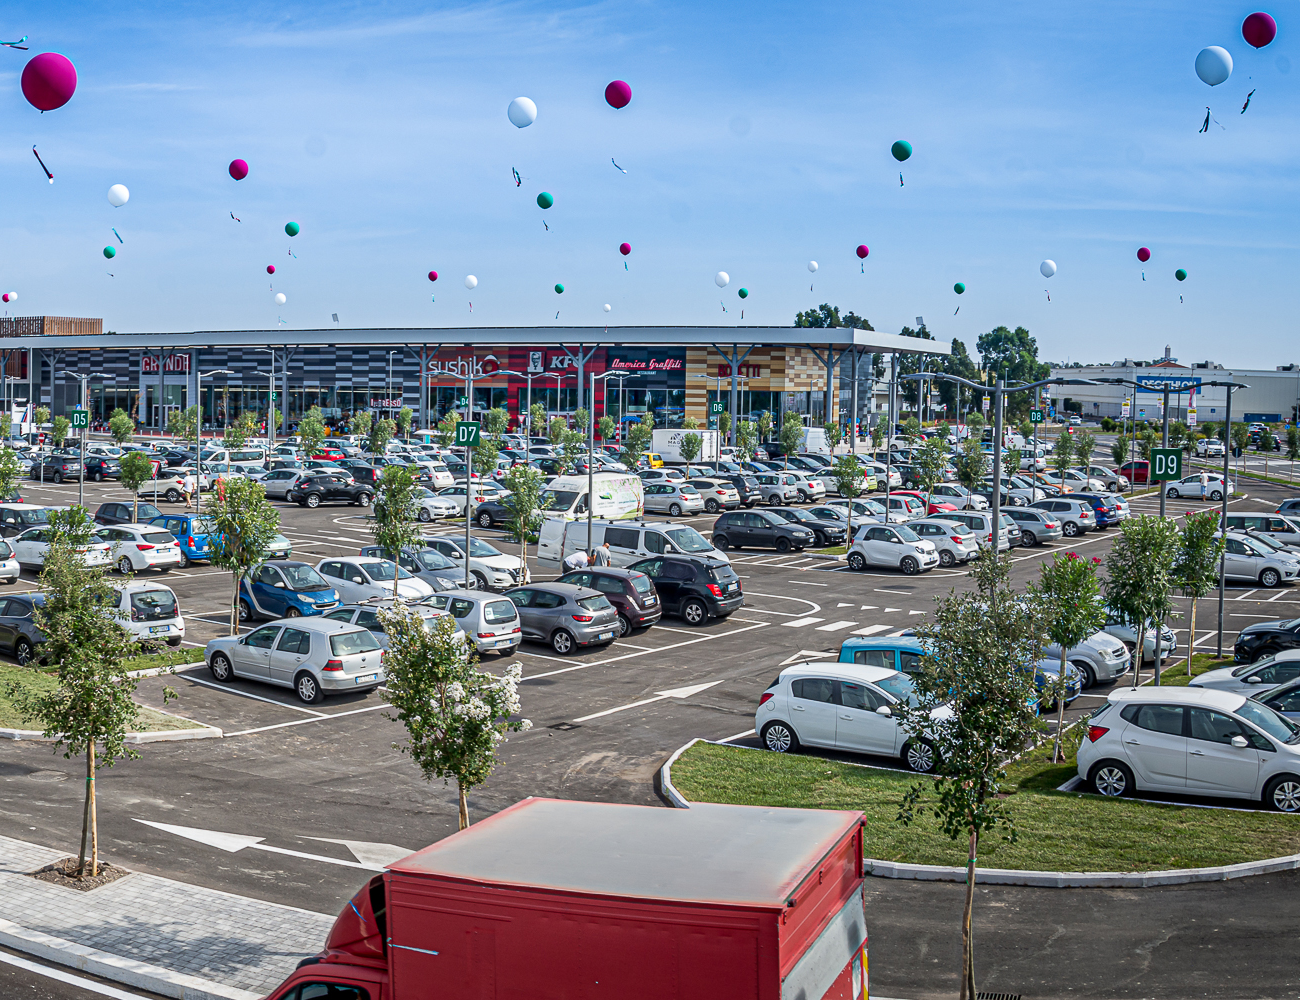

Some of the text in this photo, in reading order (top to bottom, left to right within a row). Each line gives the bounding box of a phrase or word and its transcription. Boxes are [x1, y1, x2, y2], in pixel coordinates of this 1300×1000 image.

[142, 355, 191, 371] GRNDE
[612, 358, 683, 370] America Graffiti
[713, 403, 723, 412] D6
[73, 413, 86, 426] D5
[1031, 412, 1042, 421] D8
[459, 426, 477, 442] D7
[1156, 455, 1177, 475] D9
